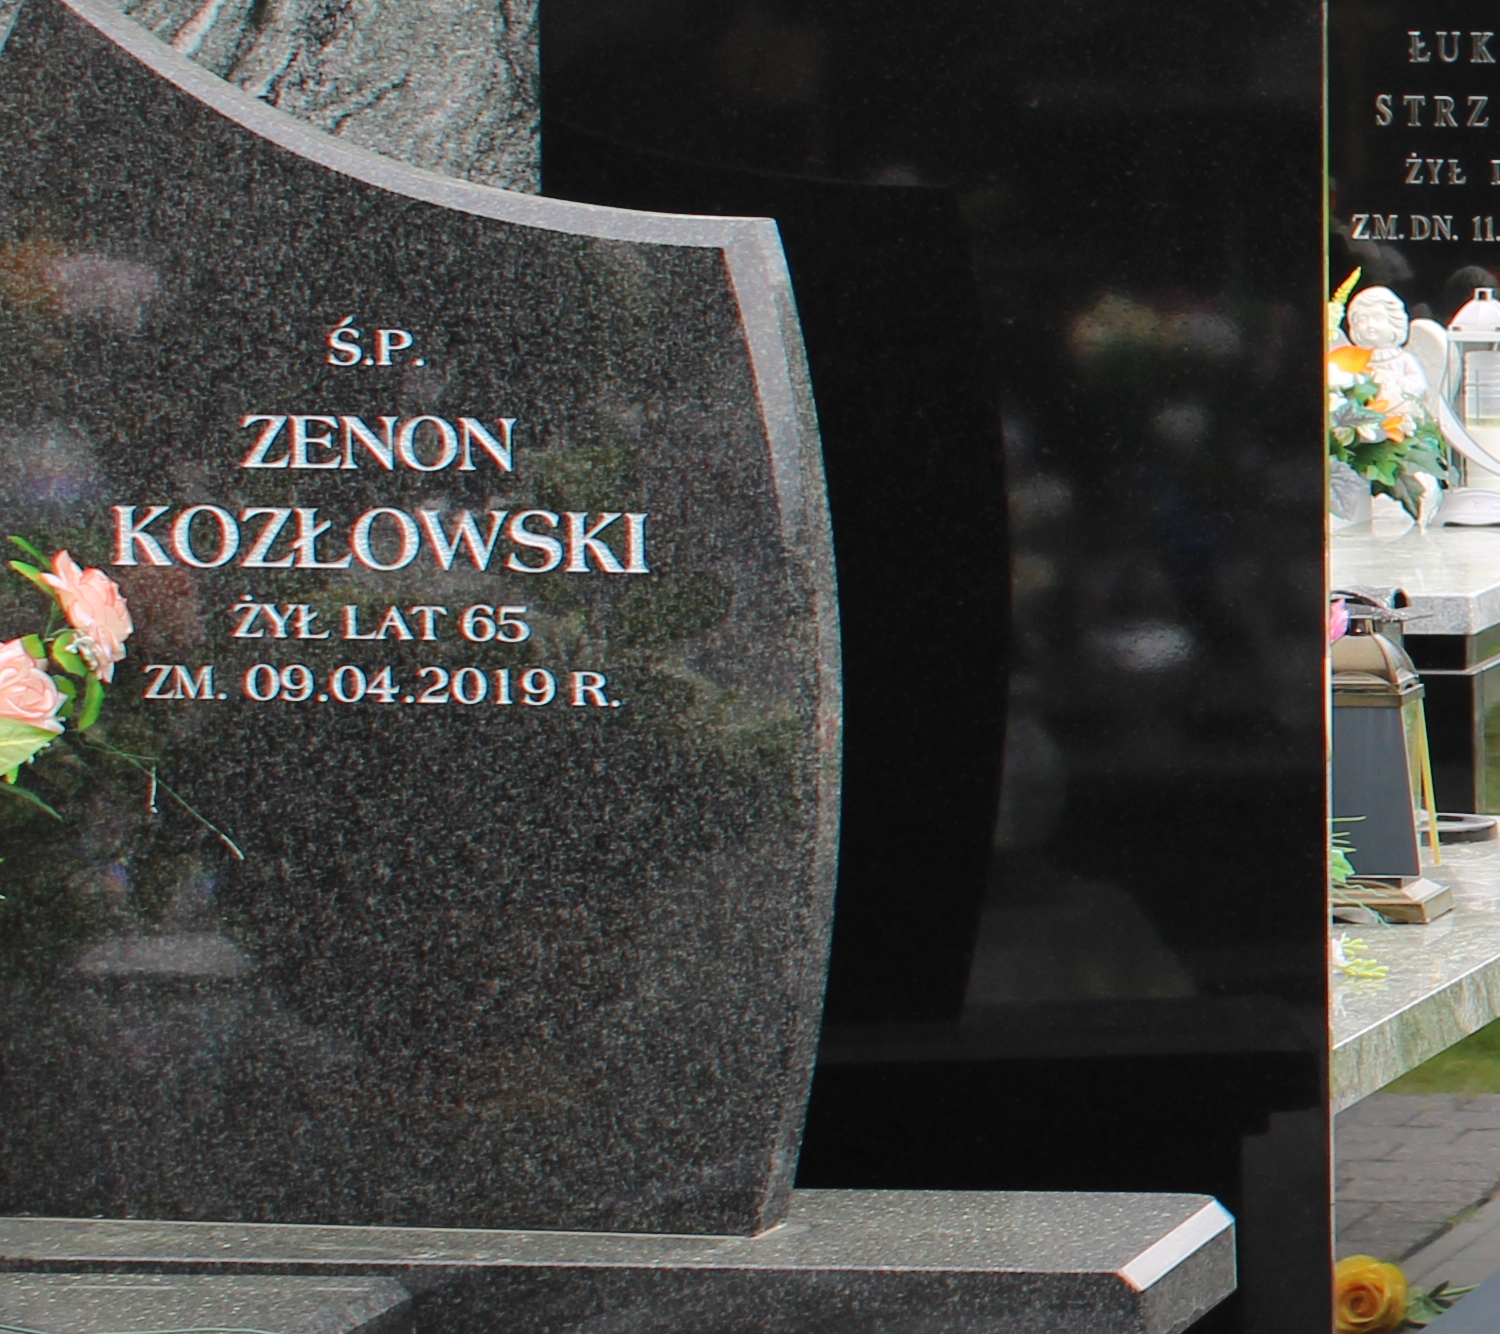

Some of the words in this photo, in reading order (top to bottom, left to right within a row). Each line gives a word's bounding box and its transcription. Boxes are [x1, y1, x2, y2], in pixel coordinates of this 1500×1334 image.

[1404, 152, 1467, 186] ŻYŁ
[327, 316, 426, 368] Ś.P.
[240, 414, 517, 472] ZENON
[111, 503, 650, 575] KOZŁOWSKI
[231, 595, 331, 641] ŻYŁ
[344, 604, 447, 641] LAT
[460, 603, 531, 644] 65
[143, 665, 227, 701] ZM.
[244, 664, 555, 708] 09.04.2019
[570, 671, 622, 709] R.
